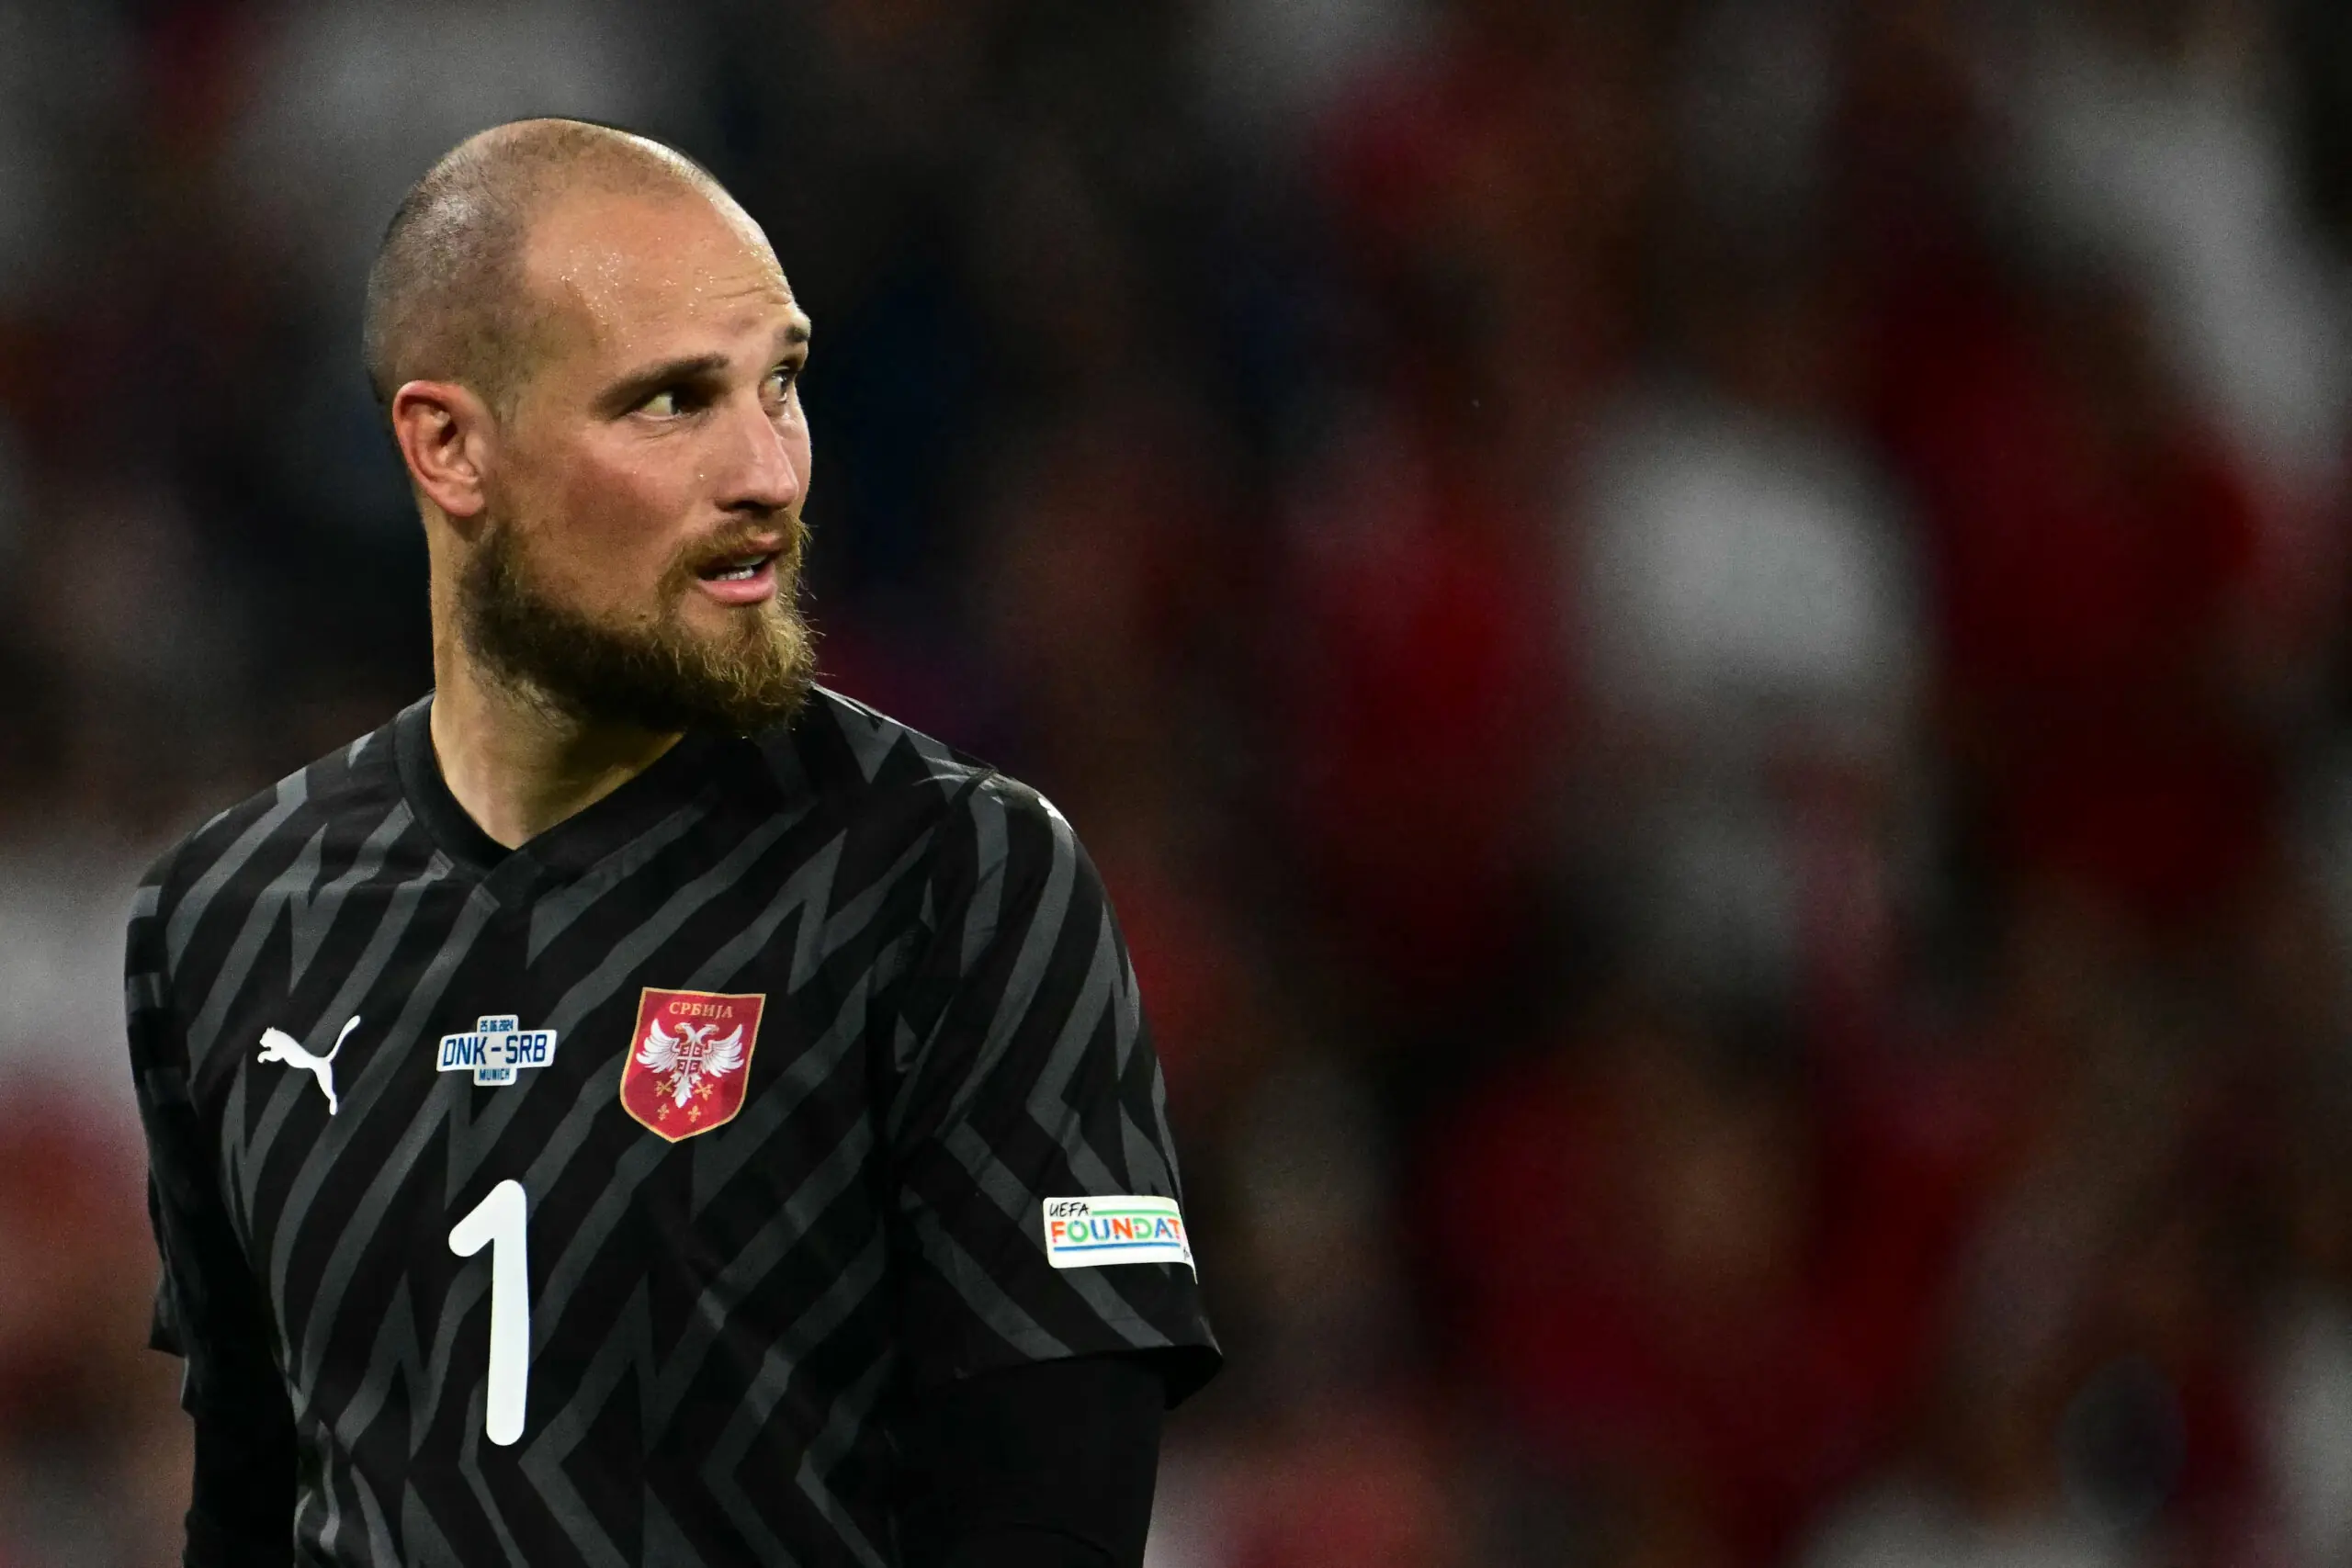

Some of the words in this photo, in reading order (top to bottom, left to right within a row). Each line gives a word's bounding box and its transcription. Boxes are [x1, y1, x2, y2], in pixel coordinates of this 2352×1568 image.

[669, 1001, 733, 1019] СРБИЈА
[479, 1068, 510, 1081] MUNICH
[1049, 1201, 1089, 1217] UEFA
[448, 1179, 529, 1446] 1
